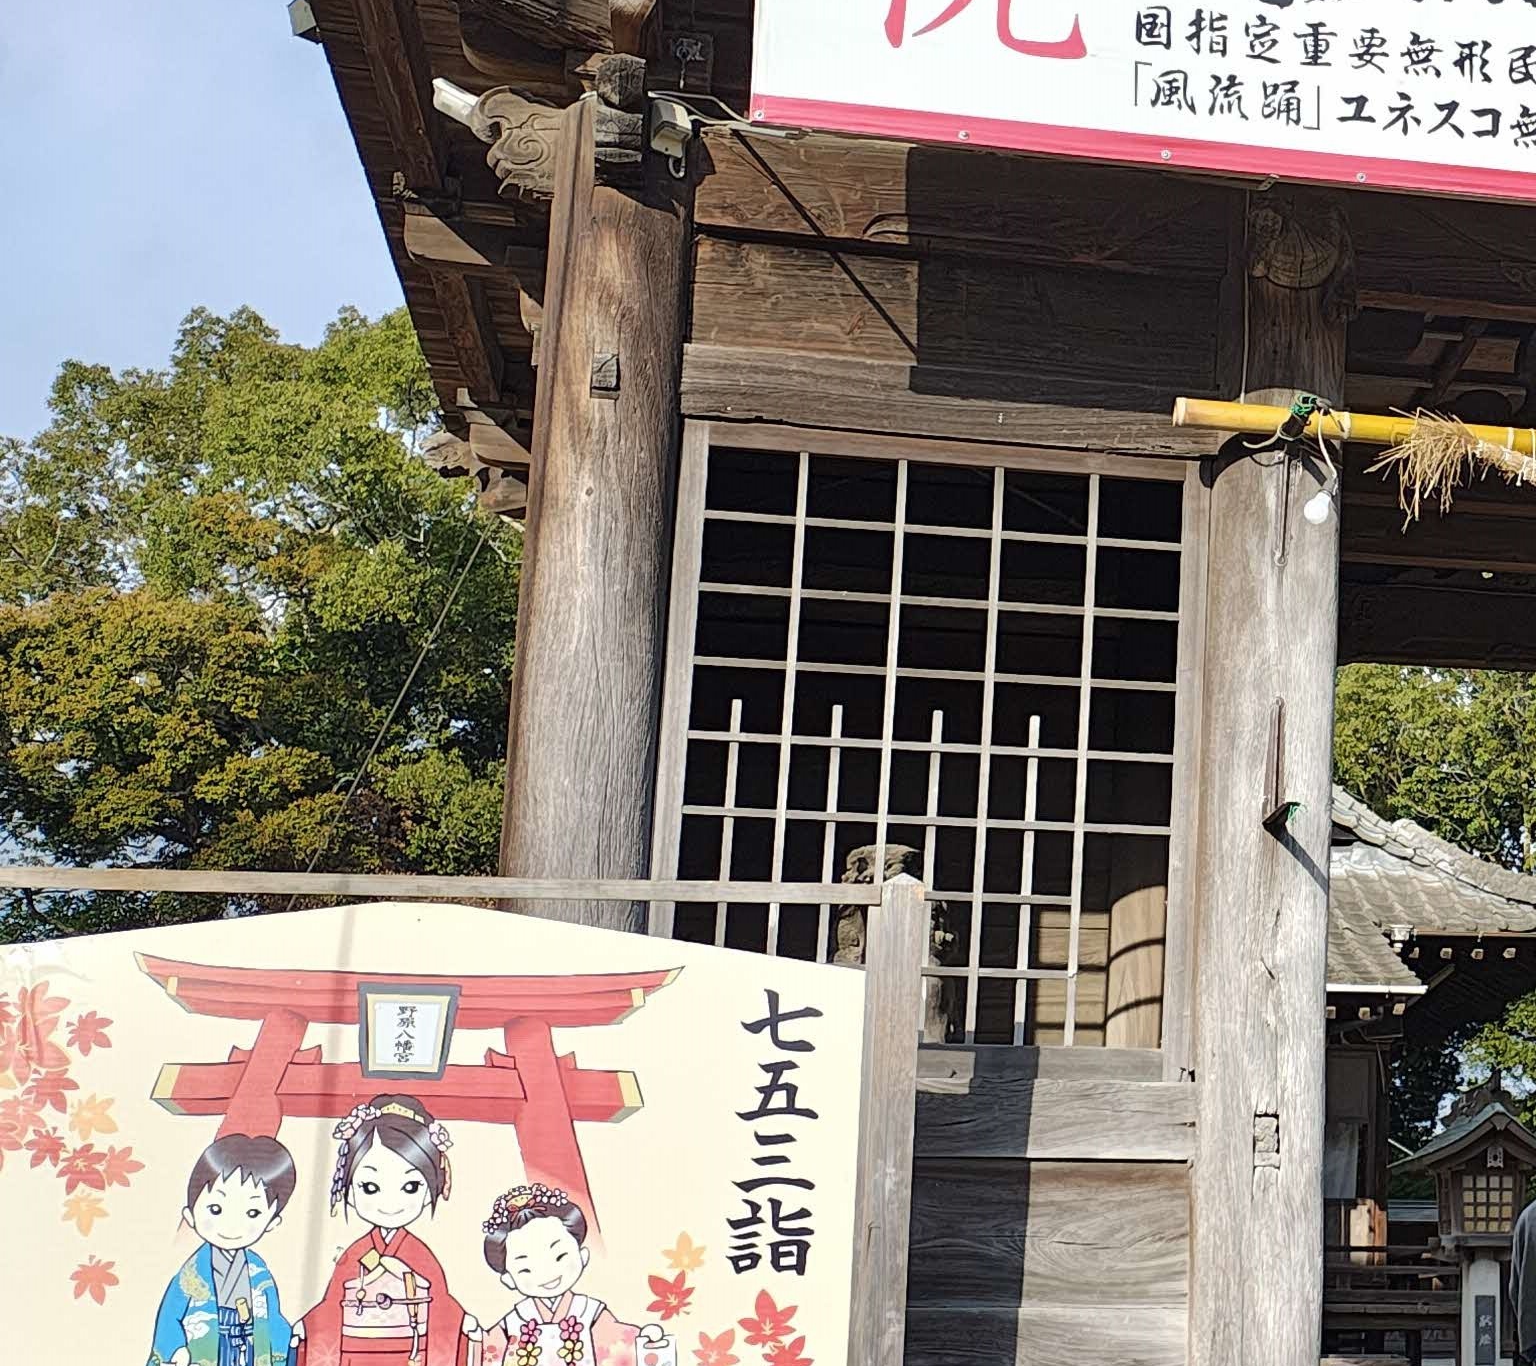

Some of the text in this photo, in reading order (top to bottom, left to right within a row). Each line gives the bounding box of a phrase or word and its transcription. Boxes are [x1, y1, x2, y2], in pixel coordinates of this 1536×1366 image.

[394, 1006, 418, 1063] 野原八幡宮
[724, 988, 826, 1277] 七五三詣
